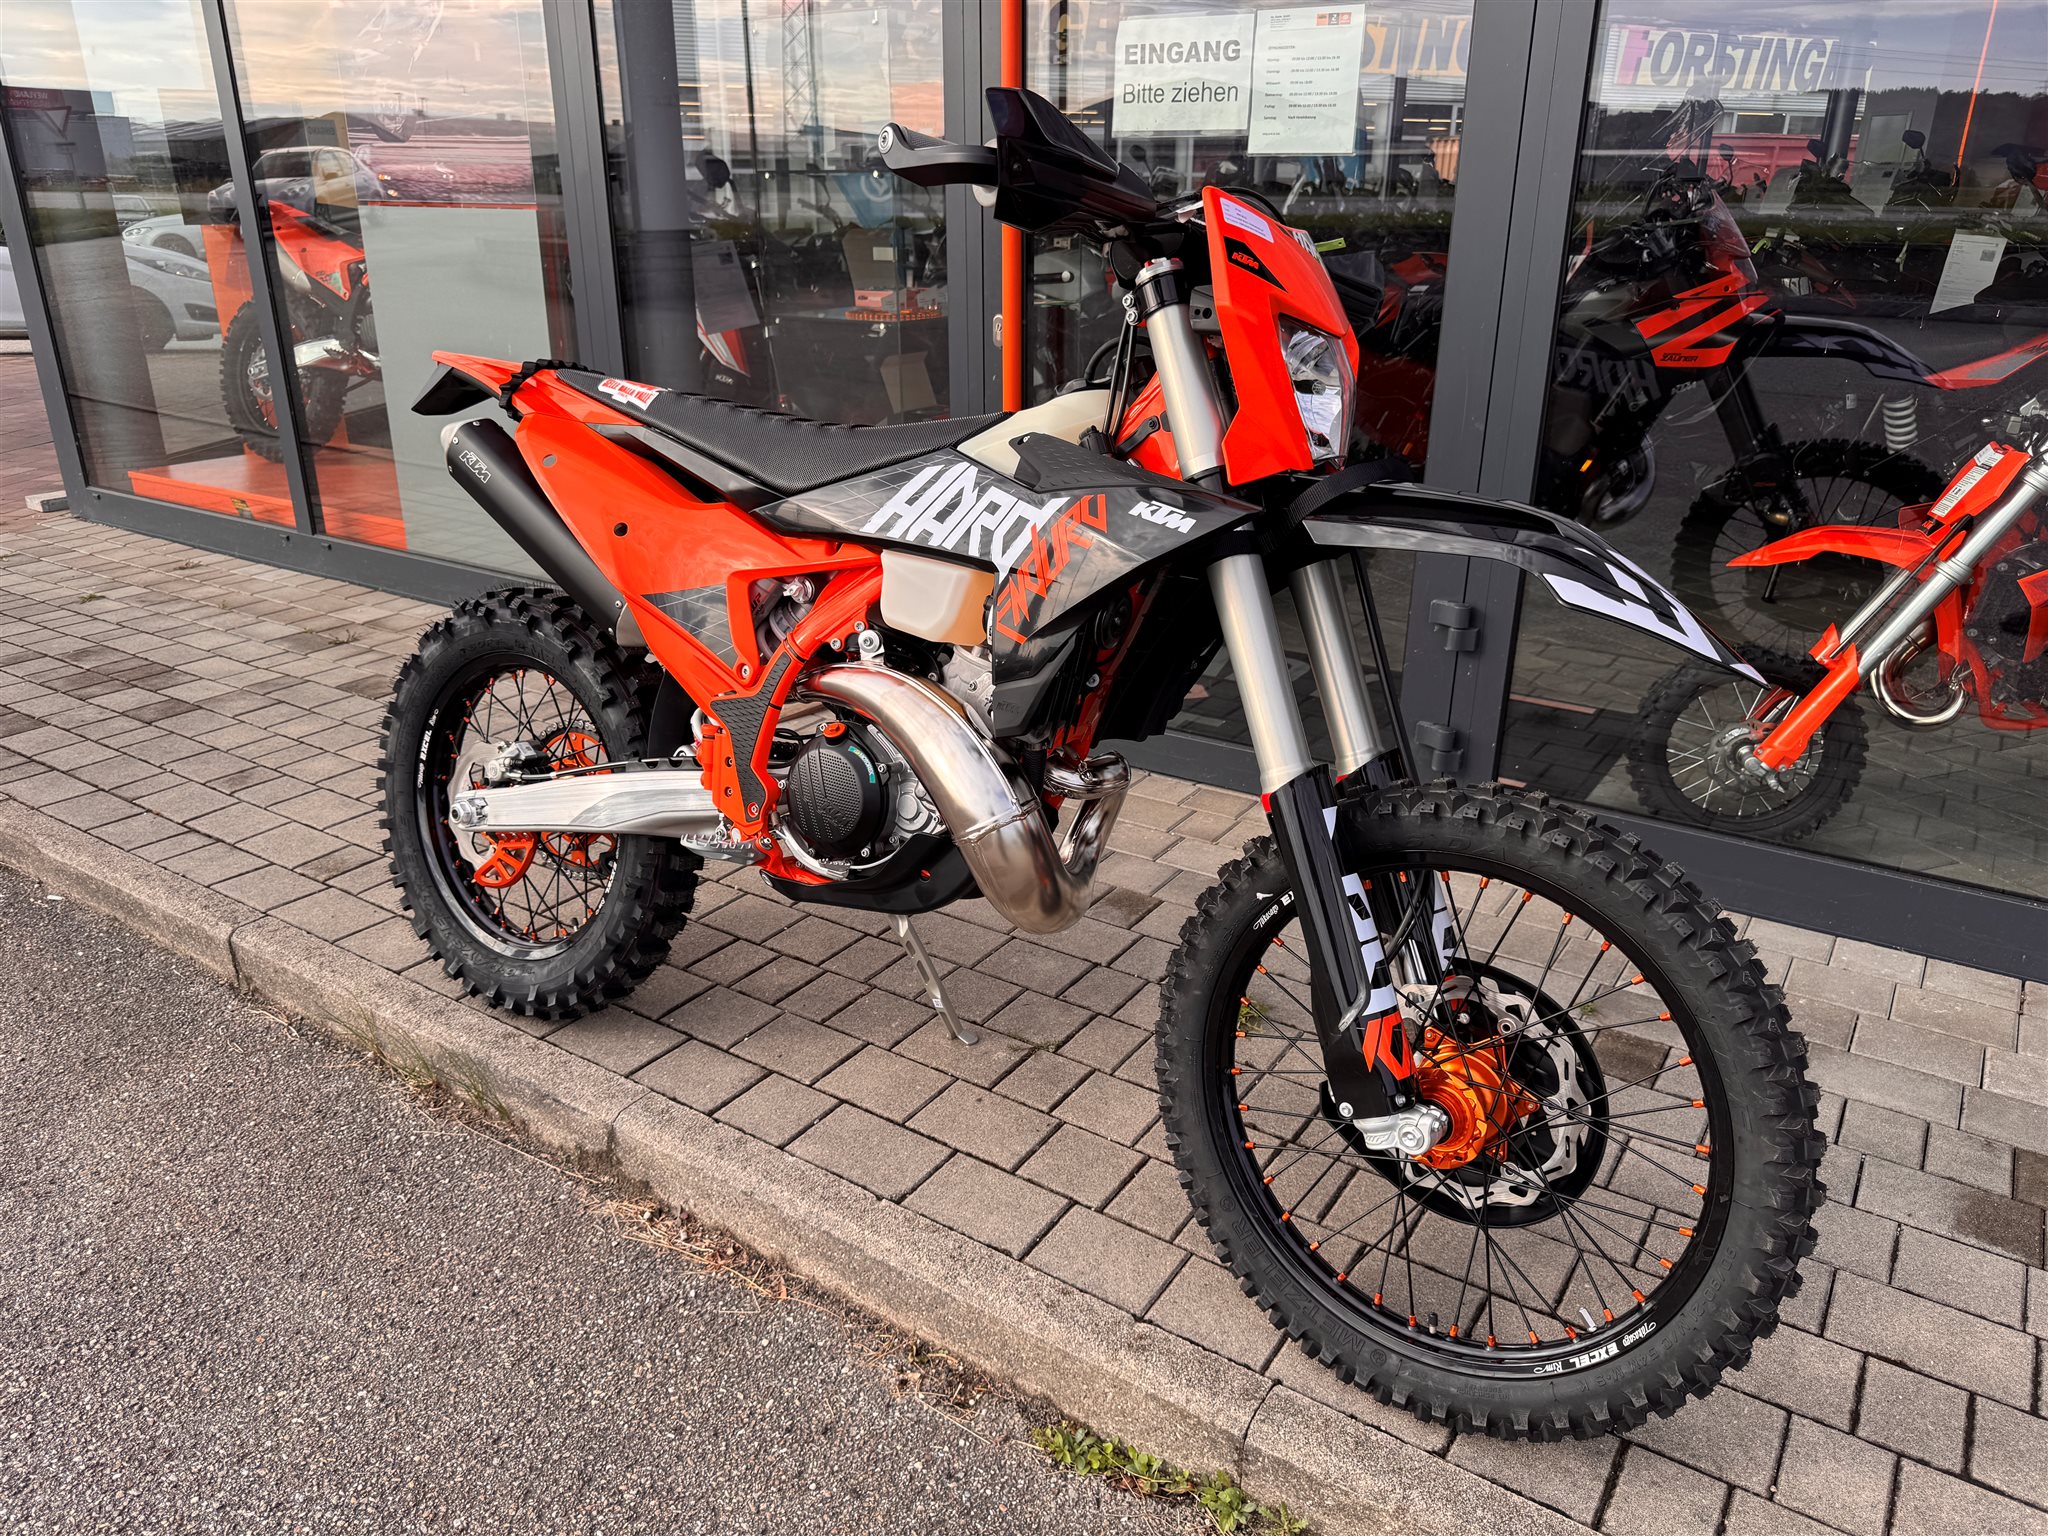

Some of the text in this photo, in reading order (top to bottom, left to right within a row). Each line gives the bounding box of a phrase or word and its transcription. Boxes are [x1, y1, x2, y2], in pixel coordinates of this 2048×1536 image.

[1124, 39, 1242, 66] EINGANG
[1122, 81, 1239, 105] Bitte ziehen
[1231, 251, 1260, 270] KTM
[459, 450, 492, 484] KTM
[859, 461, 1070, 585] HARD
[1128, 500, 1197, 535] KTM
[996, 493, 1109, 644] ENDURO
[1231, 1214, 1367, 1353] METZELER
[1622, 1321, 1657, 1347] Takasago
[1569, 1341, 1620, 1369] EXCEL
